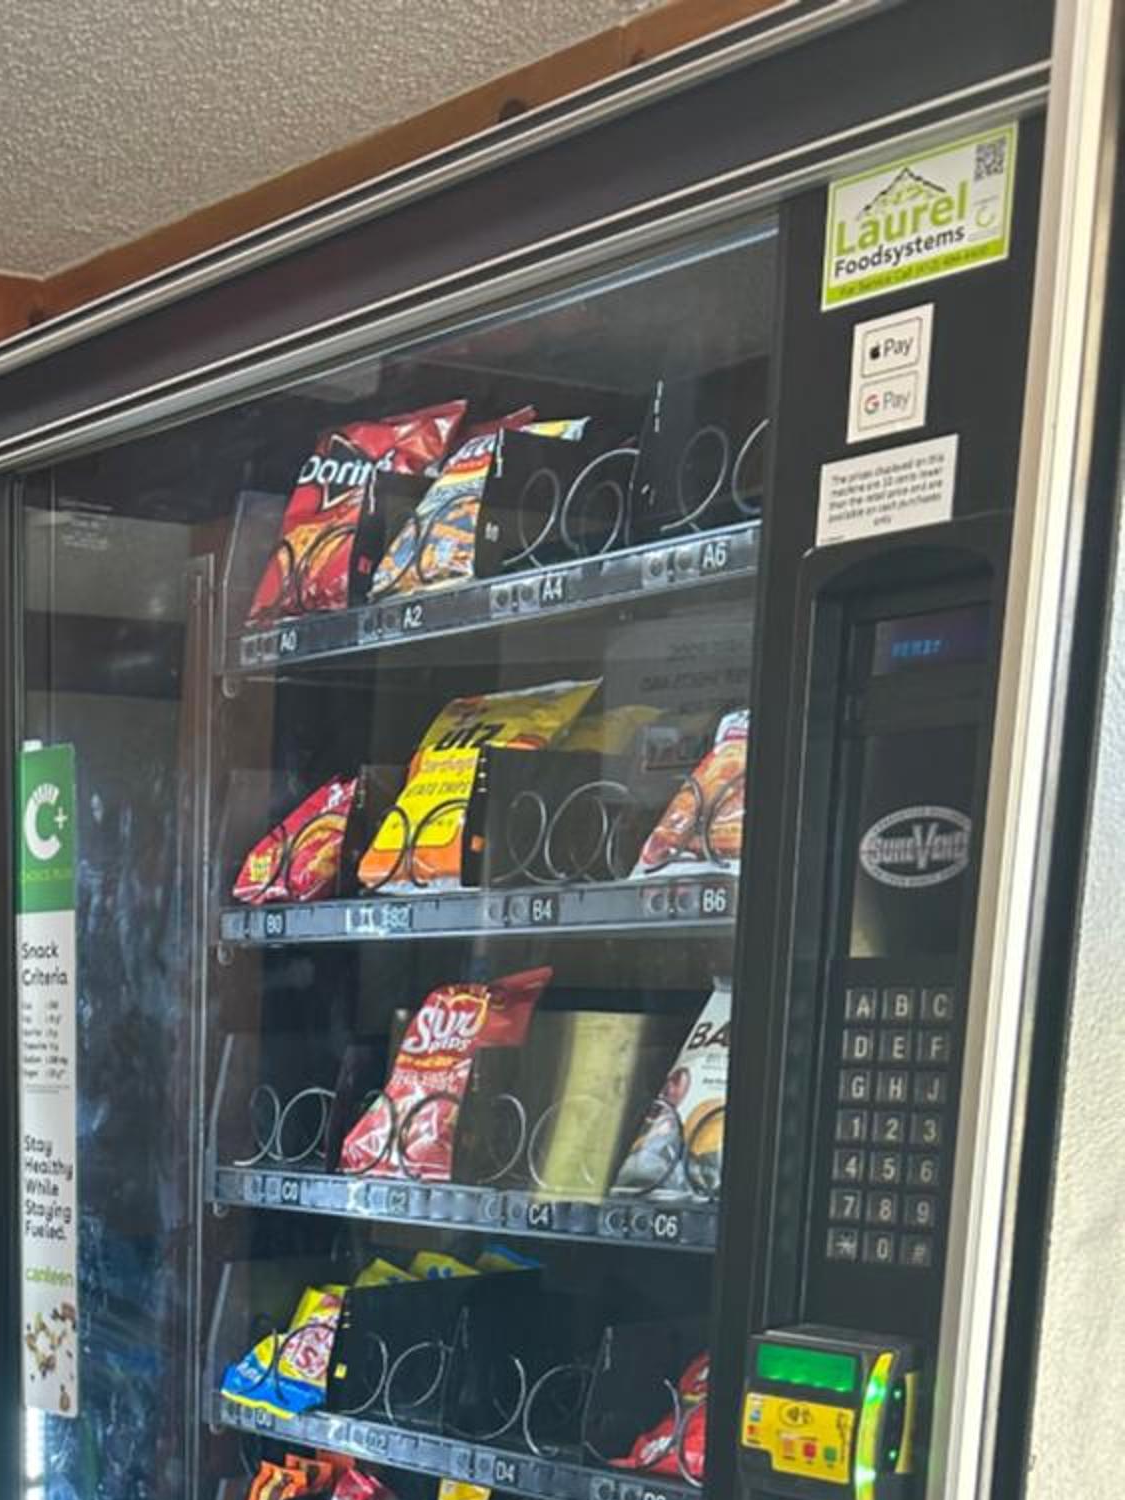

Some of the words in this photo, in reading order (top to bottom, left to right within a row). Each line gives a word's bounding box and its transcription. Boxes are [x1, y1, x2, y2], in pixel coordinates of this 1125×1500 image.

[835, 180, 968, 257] Laurel
[834, 226, 966, 279] Foodsystems
[883, 337, 913, 357] Pay
[883, 390, 911, 410] Pay
[703, 543, 728, 569] A6
[540, 580, 564, 602] A4
[403, 606, 424, 628] A2
[533, 899, 554, 921] B4
[703, 888, 727, 913] B6
[22, 940, 59, 960] Snack
[856, 995, 870, 1018] A
[894, 994, 908, 1017] B
[933, 993, 946, 1016] C
[854, 1036, 868, 1058] D
[892, 1036, 906, 1059] E
[930, 1036, 943, 1059] F
[851, 1076, 865, 1098] G
[888, 1076, 903, 1099] H
[926, 1077, 940, 1101] J
[851, 1117, 861, 1138] 1
[885, 1118, 898, 1140] 2
[922, 1119, 936, 1142] 3
[25, 1135, 52, 1158] Stay
[26, 1156, 73, 1181] Healthy
[845, 1155, 857, 1178] 4
[882, 1158, 896, 1180] 5
[920, 1160, 932, 1183] 6
[26, 1177, 59, 1197] While
[25, 1199, 72, 1224] Staying
[528, 1204, 549, 1225] C4
[842, 1195, 855, 1218] 7
[878, 1198, 891, 1221] 8
[916, 1201, 930, 1224] 9
[655, 1214, 678, 1237] C6
[876, 1238, 889, 1260] 0
[494, 1461, 516, 1483] D4
